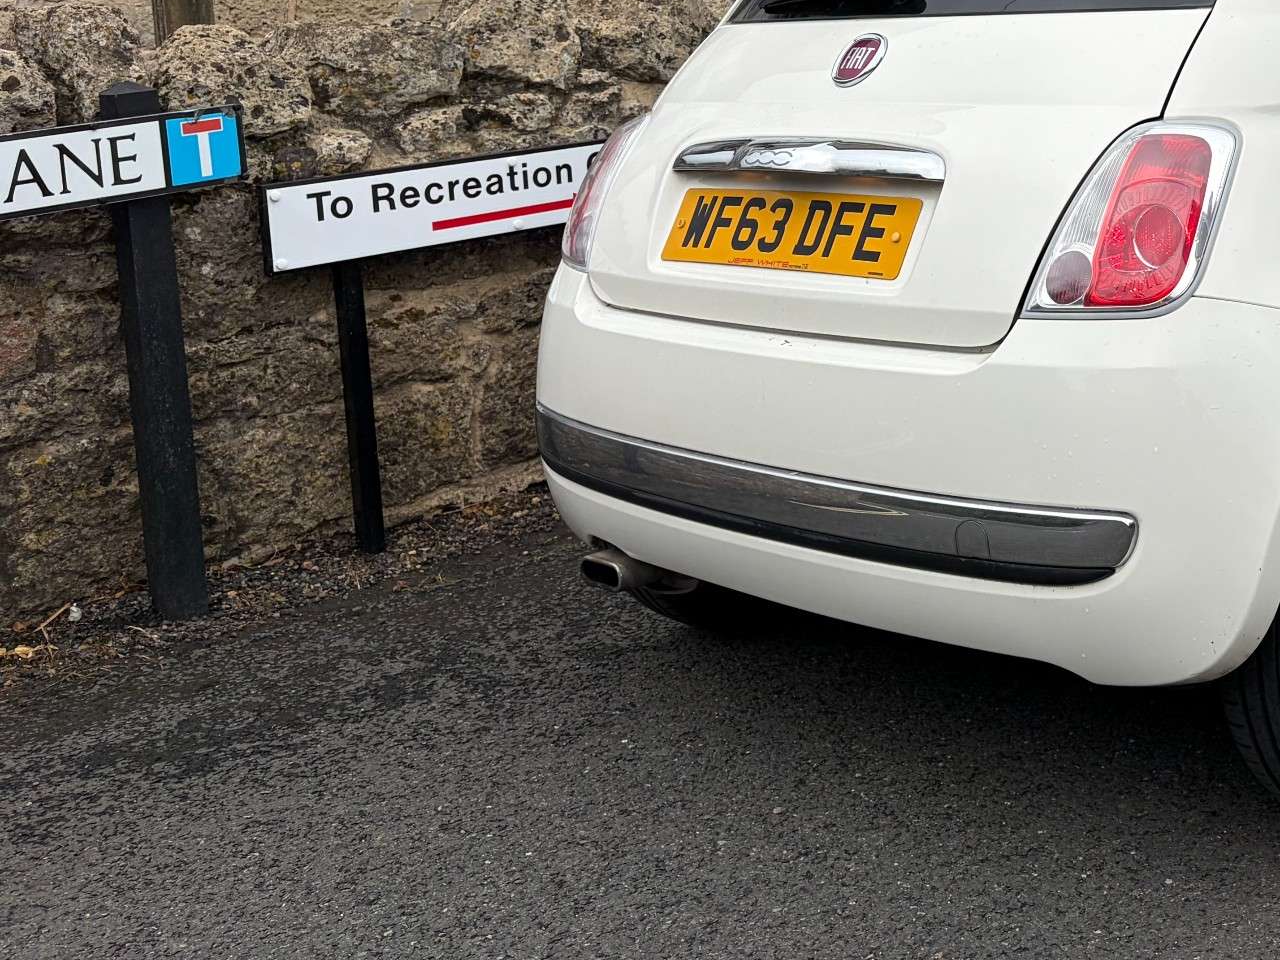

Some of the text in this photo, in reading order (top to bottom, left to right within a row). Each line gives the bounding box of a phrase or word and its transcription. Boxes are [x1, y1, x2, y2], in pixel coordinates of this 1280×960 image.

[840, 47, 876, 69] FIAT
[306, 162, 573, 222] To Recreation
[682, 196, 897, 262] WF63 DFE
